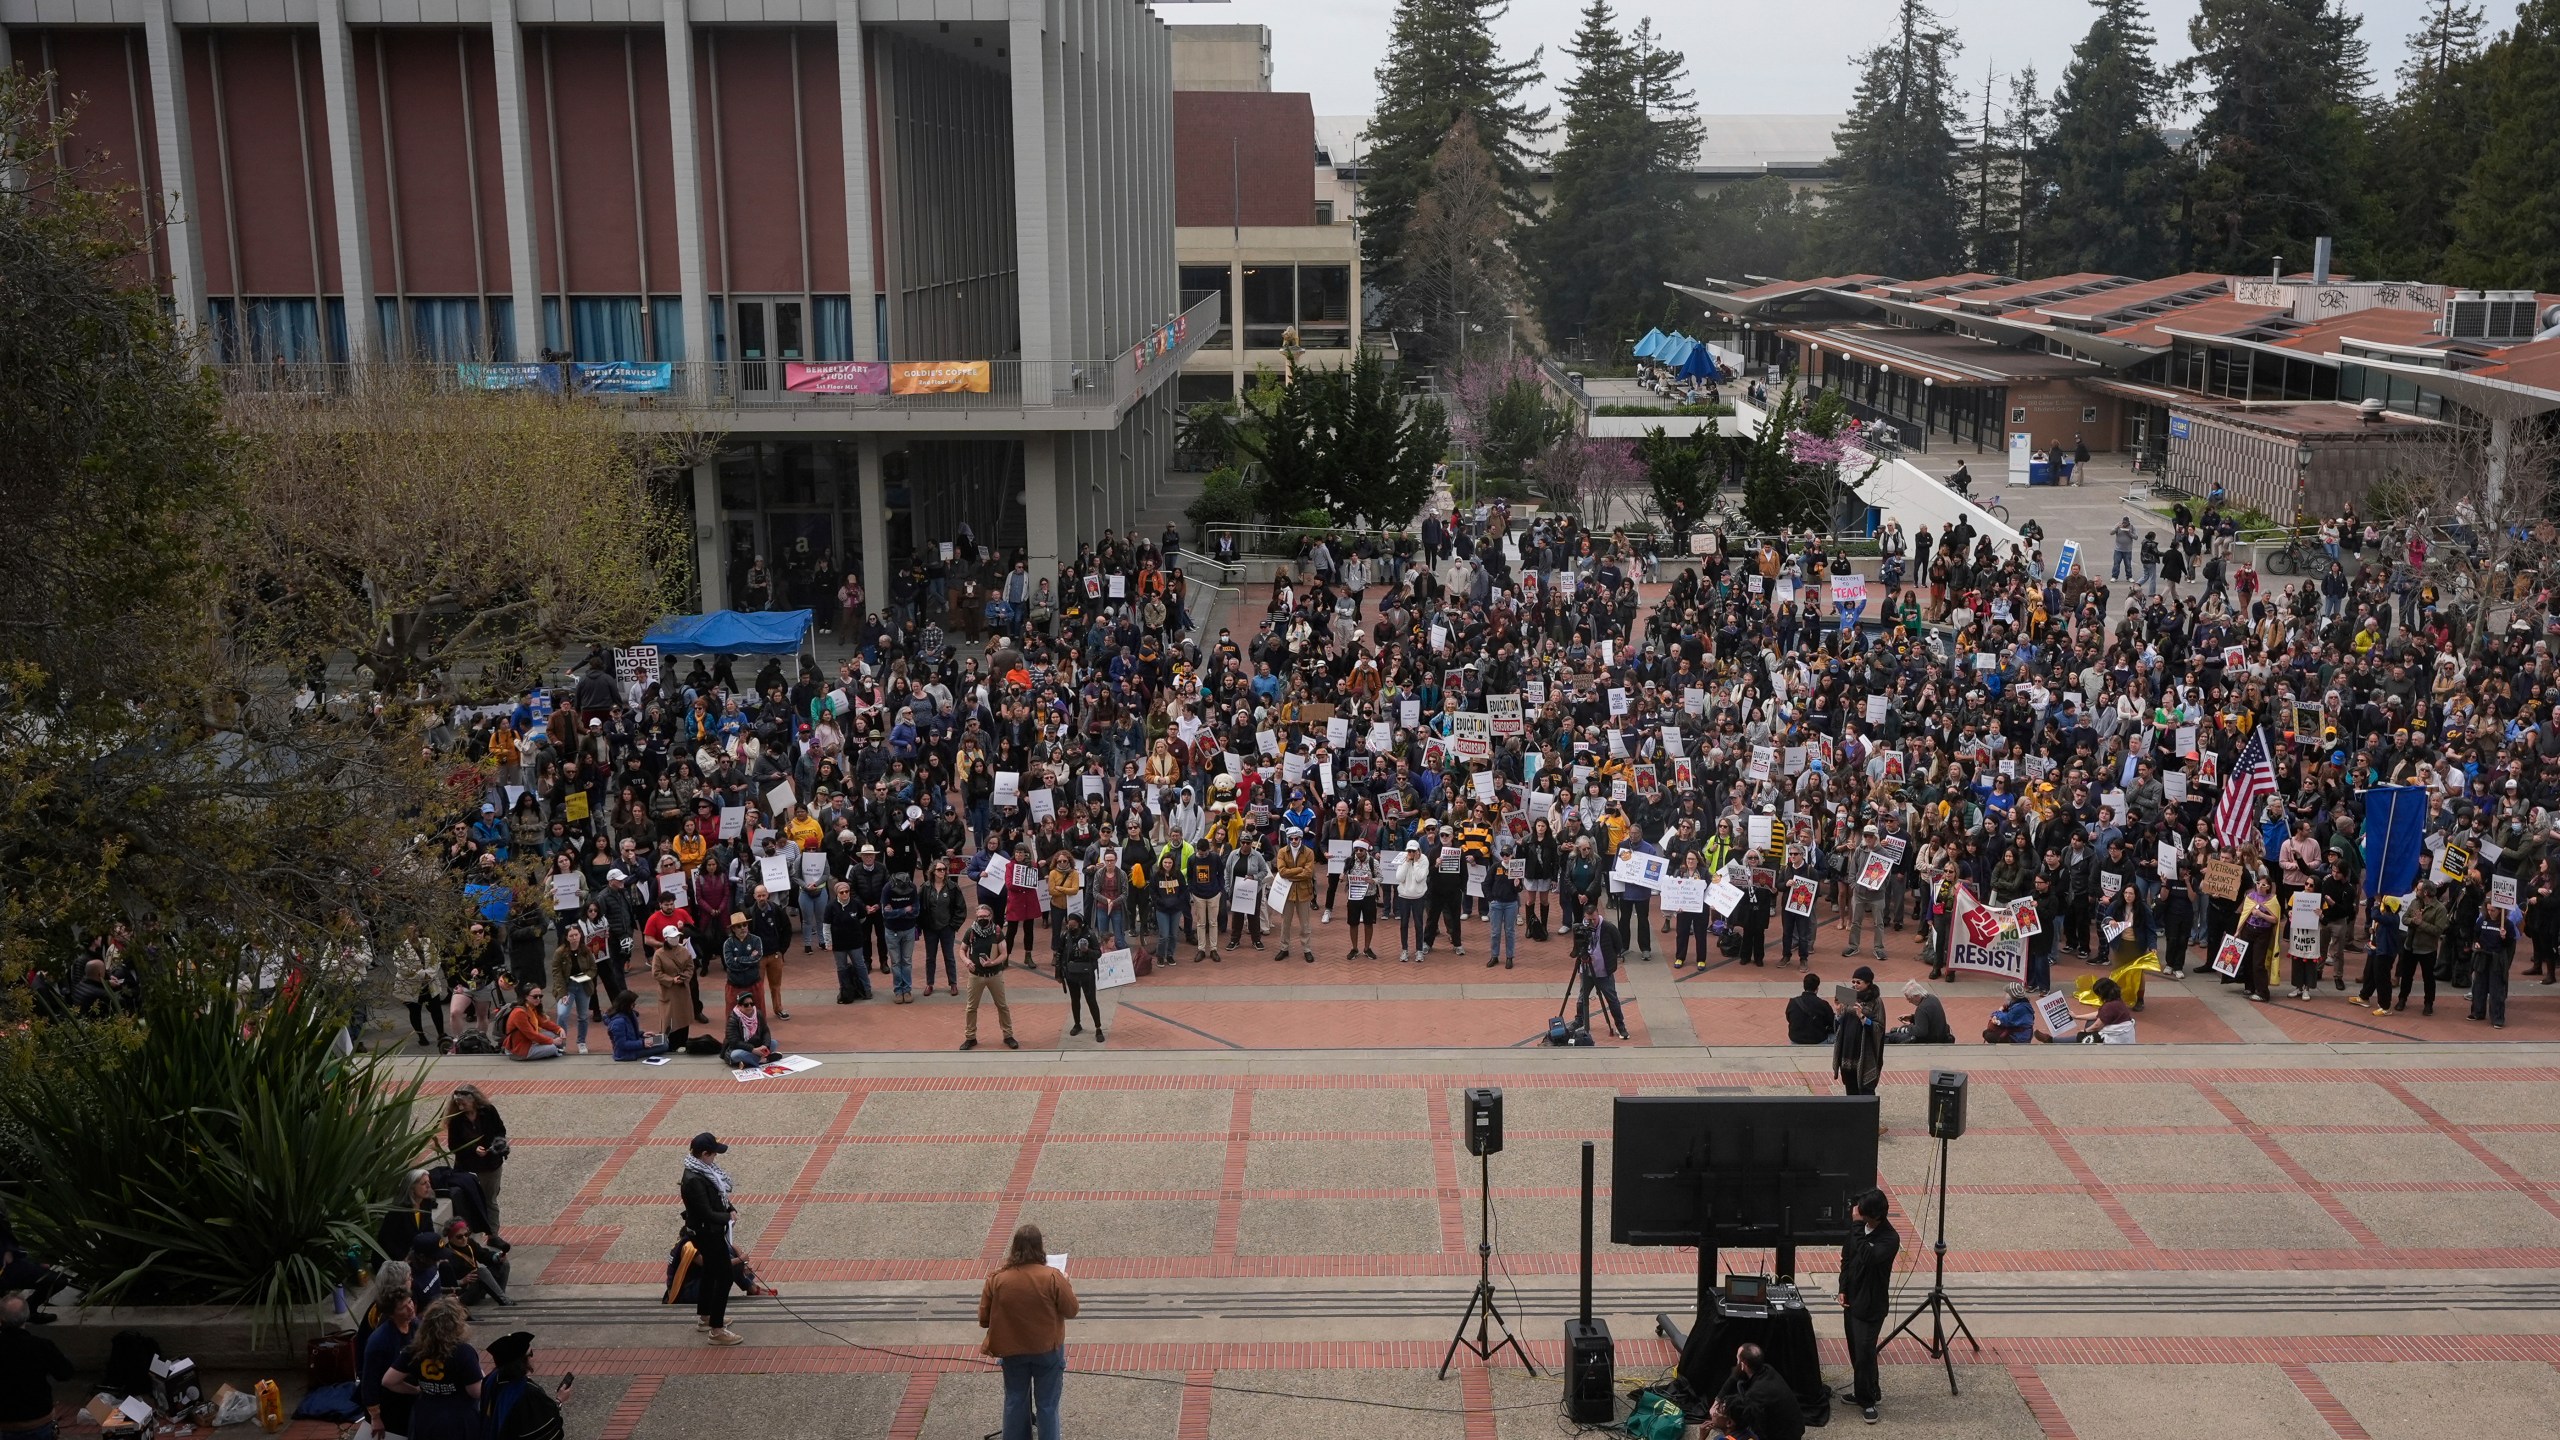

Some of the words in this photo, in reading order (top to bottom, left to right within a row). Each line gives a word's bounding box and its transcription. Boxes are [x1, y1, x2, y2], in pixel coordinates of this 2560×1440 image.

[584, 369, 613, 377] EVENT
[615, 368, 657, 377] SERVICES
[805, 365, 850, 373] BERKELEY
[851, 365, 869, 373] ART
[904, 369, 943, 377] GOLDIE'S
[946, 368, 977, 377] COFFEE
[820, 373, 854, 381] STUDIO
[1833, 585, 1866, 598] TEACH
[615, 648, 656, 658] NEED
[616, 658, 658, 668] MORE
[617, 667, 658, 675] DONRS
[1489, 699, 1519, 712] EDUCATION
[2293, 701, 2315, 710] STAND
[1456, 717, 1487, 733] EDUCATION
[1493, 720, 1520, 732] CENSORSHIP
[1458, 739, 1487, 754] CENSORSHIP
[1442, 848, 1460, 856] DEFEND
[2448, 850, 2465, 862] REFUSE
[2210, 863, 2240, 877] VETERANS
[2102, 875, 2120, 886] EDUCATION
[2208, 873, 2235, 885] AGAINST
[2207, 881, 2235, 896] TRUMP
[2493, 881, 2515, 893] EDUCATION
[2001, 929, 2019, 941] NO
[2294, 935, 2316, 944] FANGS
[2295, 943, 2312, 951] OUT!
[1955, 944, 2021, 973] RESIST!
[2043, 997, 2065, 1011] DEFEND
